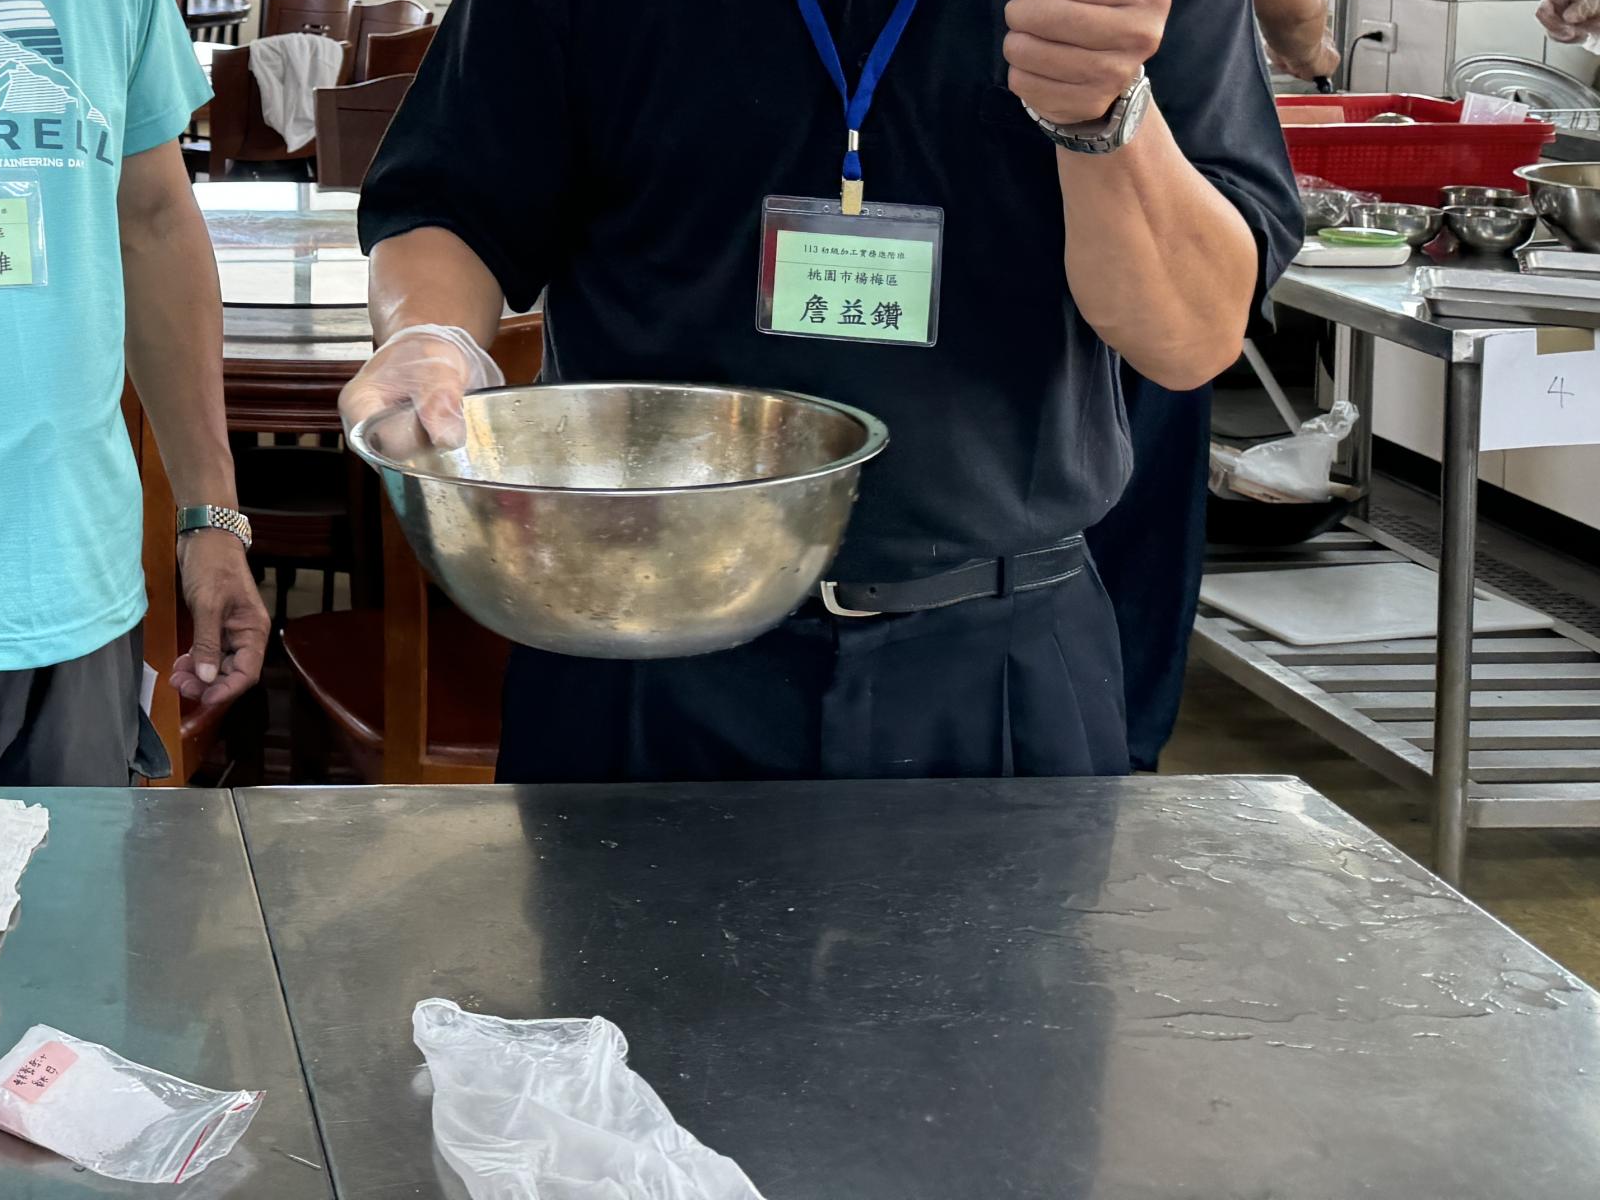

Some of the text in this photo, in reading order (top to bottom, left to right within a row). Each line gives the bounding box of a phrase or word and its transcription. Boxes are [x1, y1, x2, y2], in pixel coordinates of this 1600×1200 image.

[803, 243, 819, 254] 113
[807, 267, 899, 287] 桃園市楊梅區
[799, 293, 903, 331] 詹益鑽
[1546, 374, 1575, 409] 4
